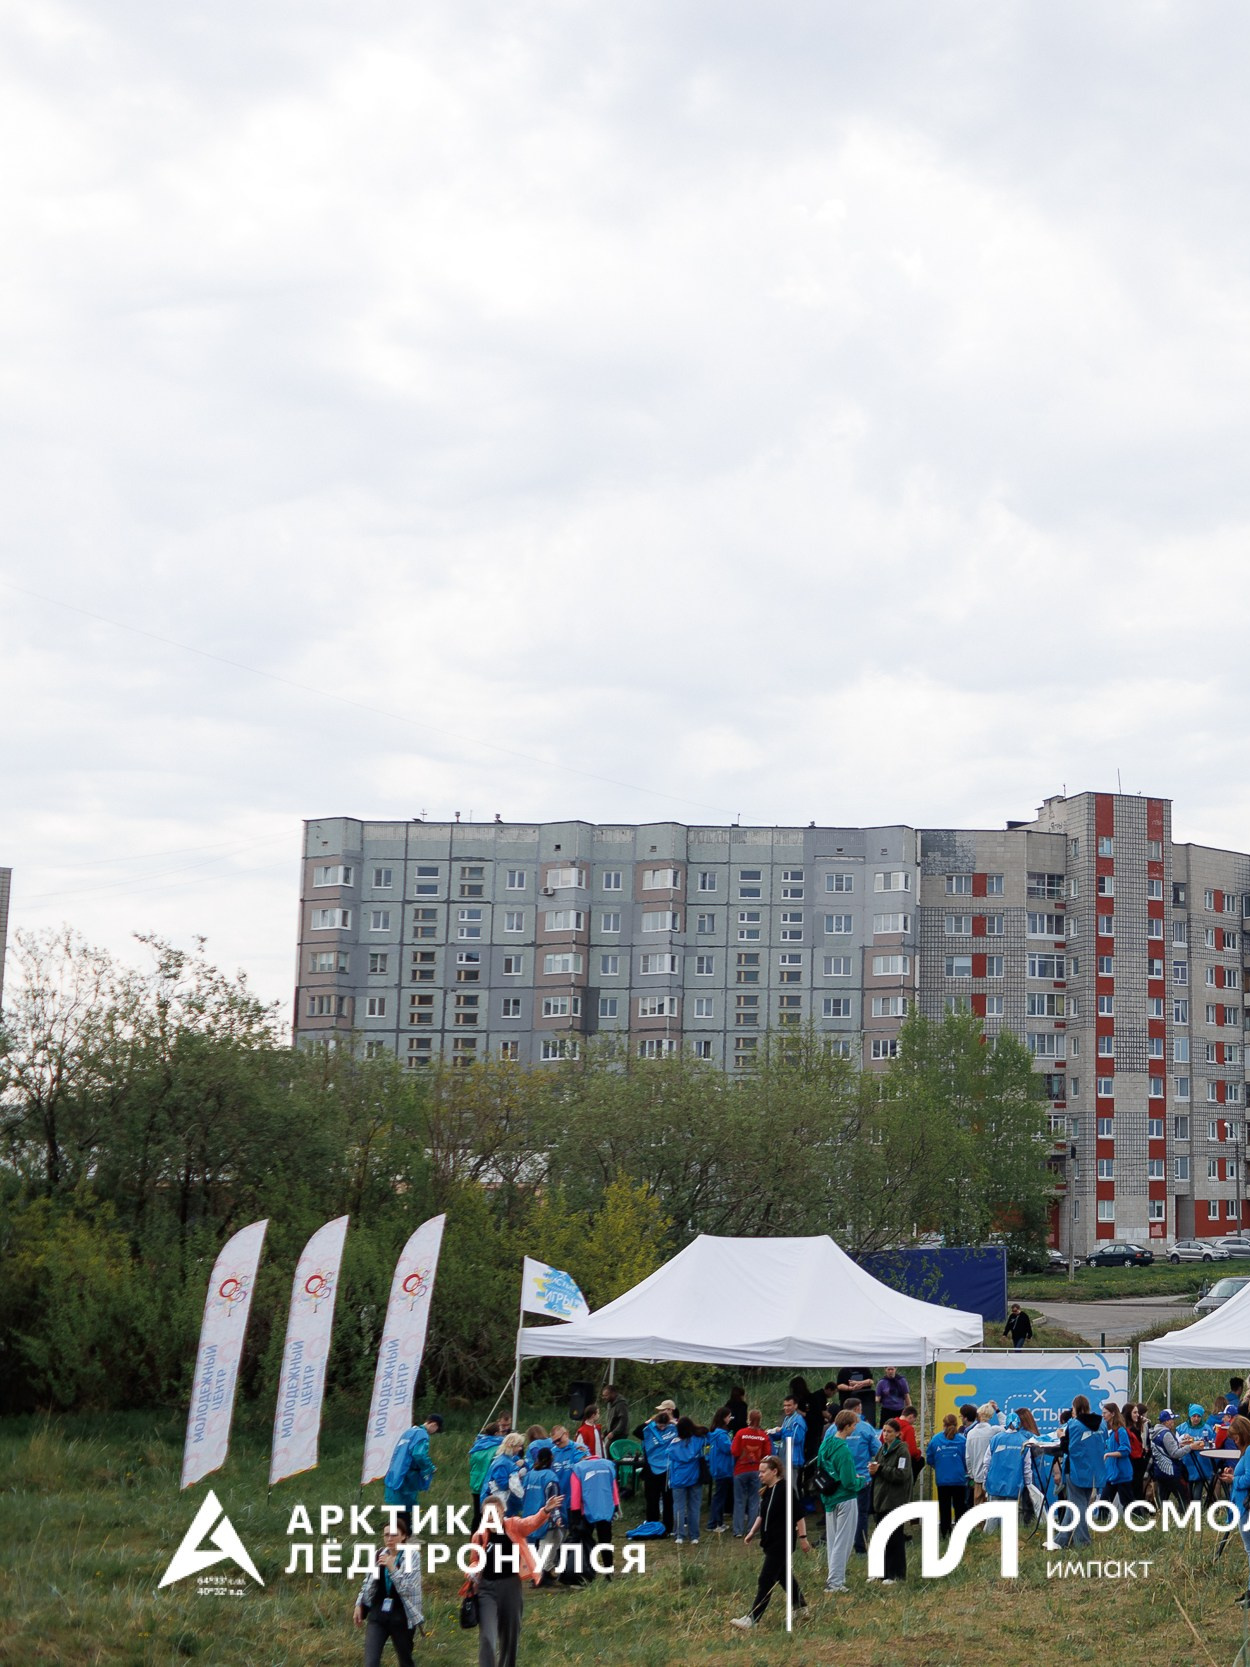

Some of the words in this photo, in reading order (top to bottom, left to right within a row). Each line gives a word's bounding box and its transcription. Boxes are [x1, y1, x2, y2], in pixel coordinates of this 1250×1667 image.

[193, 1344, 218, 1444] МОЛОДЕЖНЫЙ
[211, 1369, 227, 1411] ЦЕНТР
[281, 1340, 304, 1439] МОЛОДЕЖНЫЙ
[301, 1365, 315, 1407] ЦЕНТР
[374, 1338, 400, 1438] МОЛОДЕЖНЫЙ
[394, 1362, 410, 1406] ЦЕНТР
